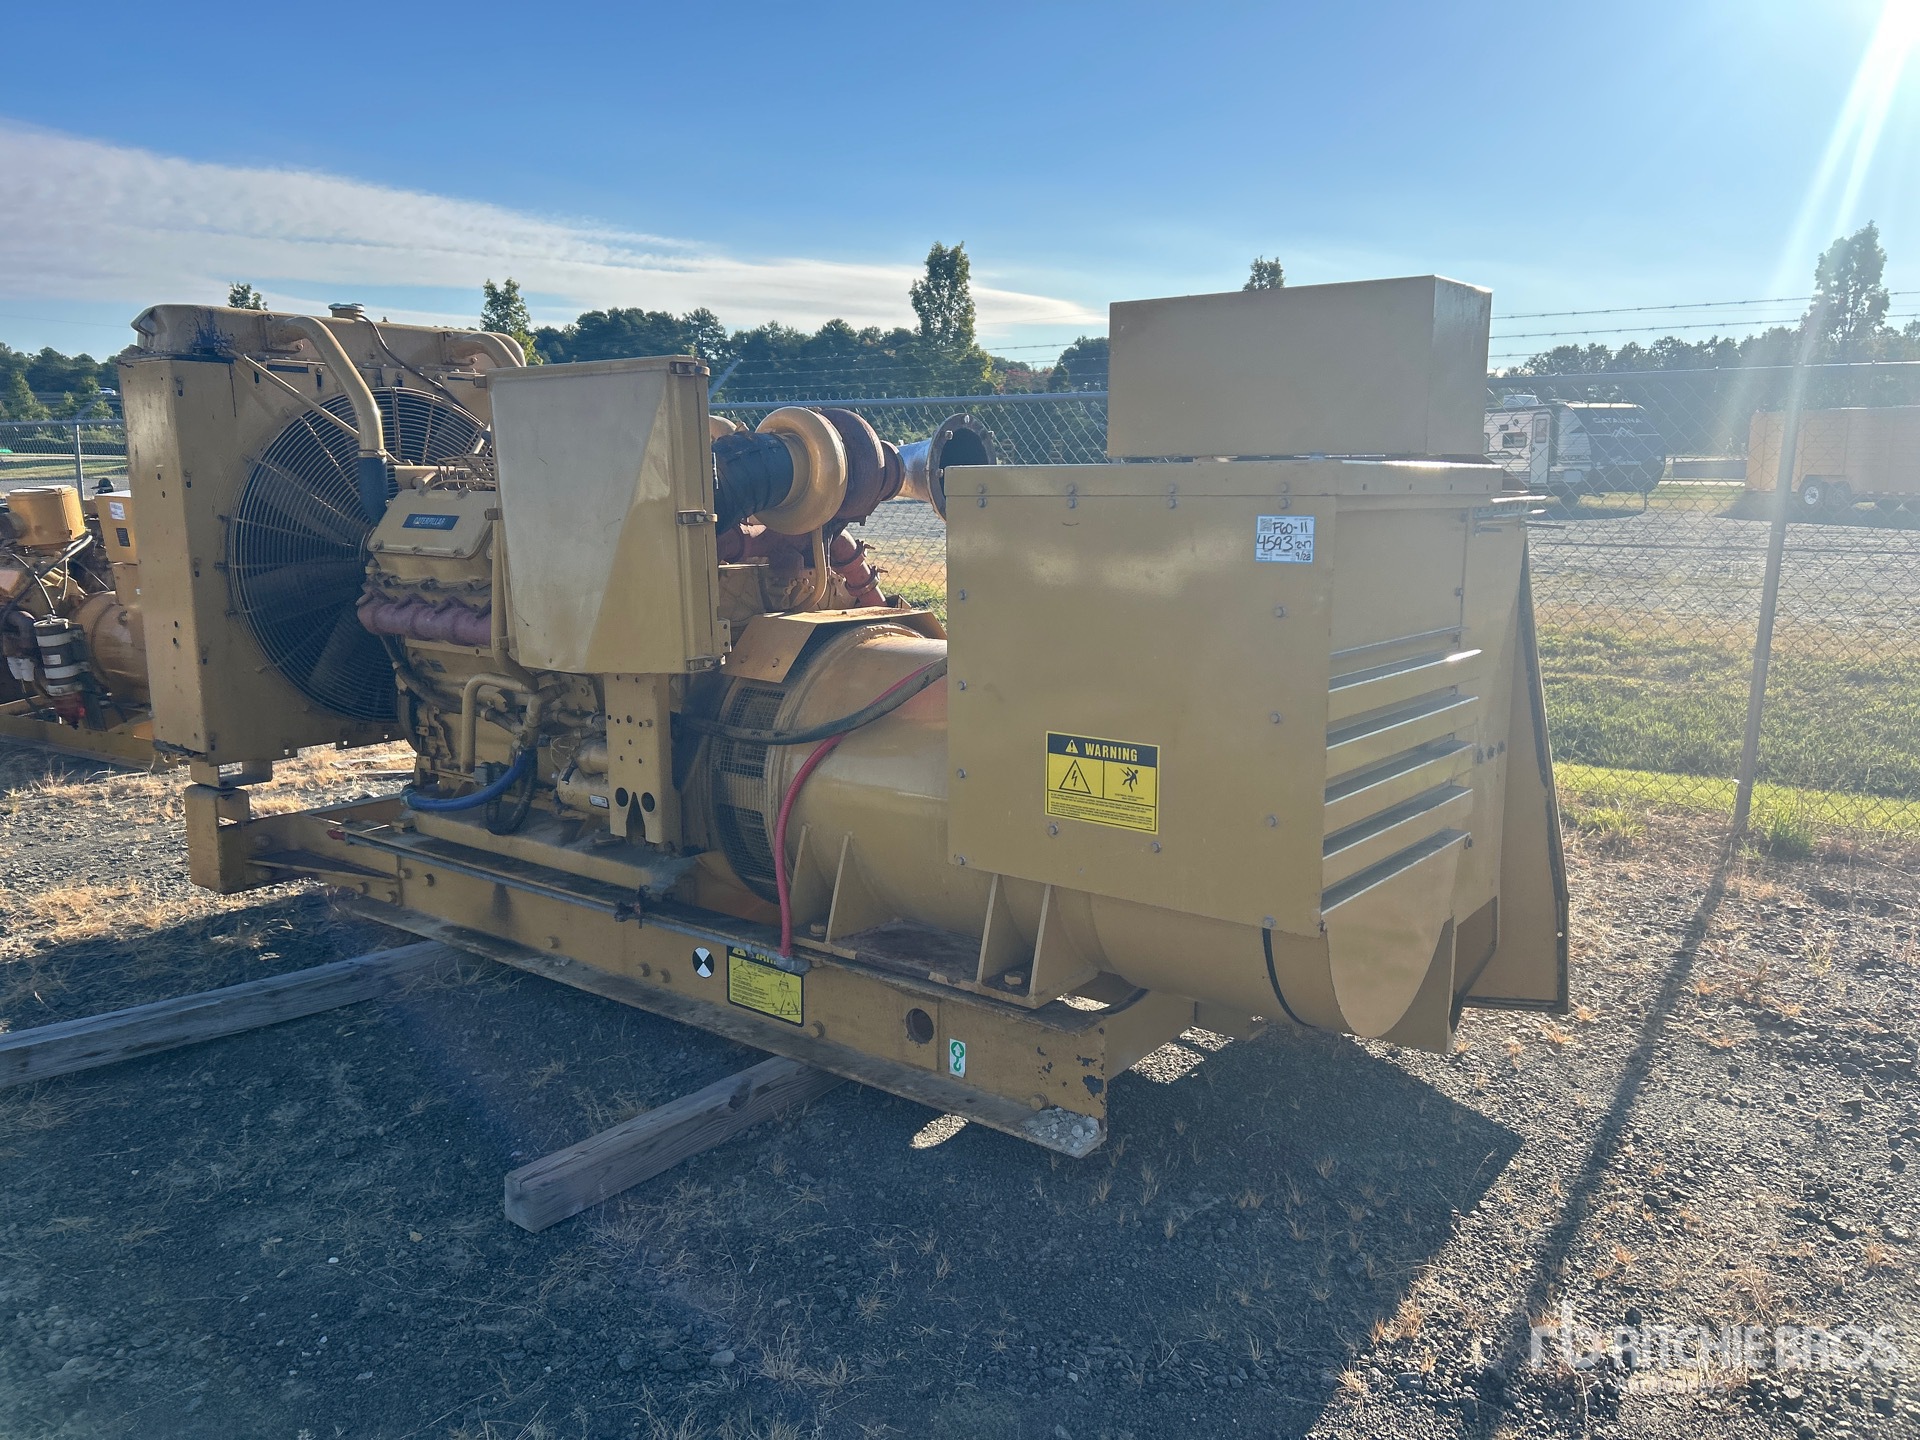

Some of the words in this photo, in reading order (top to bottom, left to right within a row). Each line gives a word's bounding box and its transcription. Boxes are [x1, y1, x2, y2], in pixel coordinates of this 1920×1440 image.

[1273, 521, 1308, 534] F60-11
[1257, 534, 1293, 551] 4593
[1085, 742, 1138, 761] WARNING
